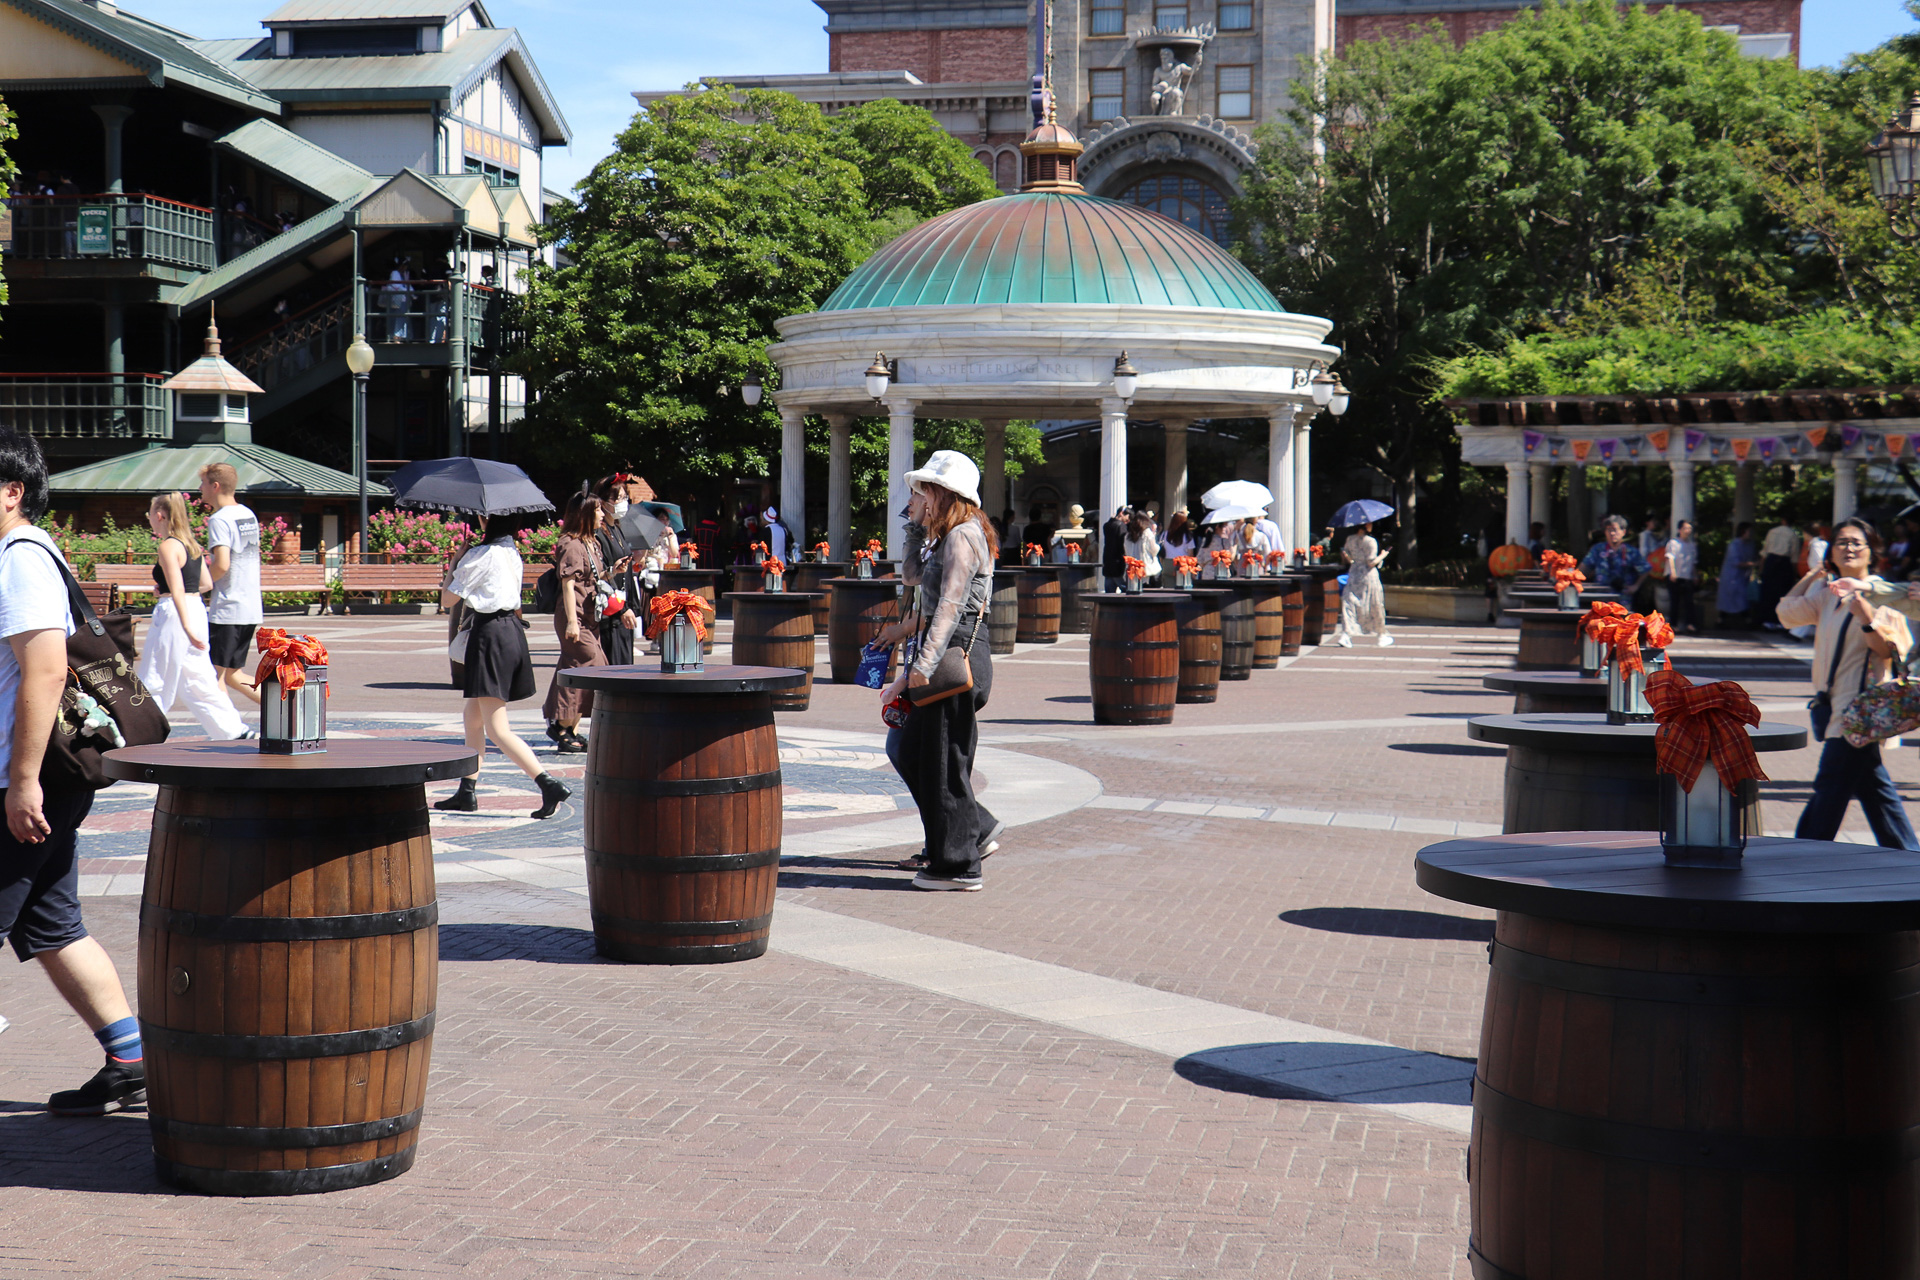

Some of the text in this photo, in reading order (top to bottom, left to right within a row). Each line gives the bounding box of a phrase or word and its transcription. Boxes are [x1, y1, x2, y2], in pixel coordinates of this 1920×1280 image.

[925, 363, 1080, 375] A SHELTERING TREE
